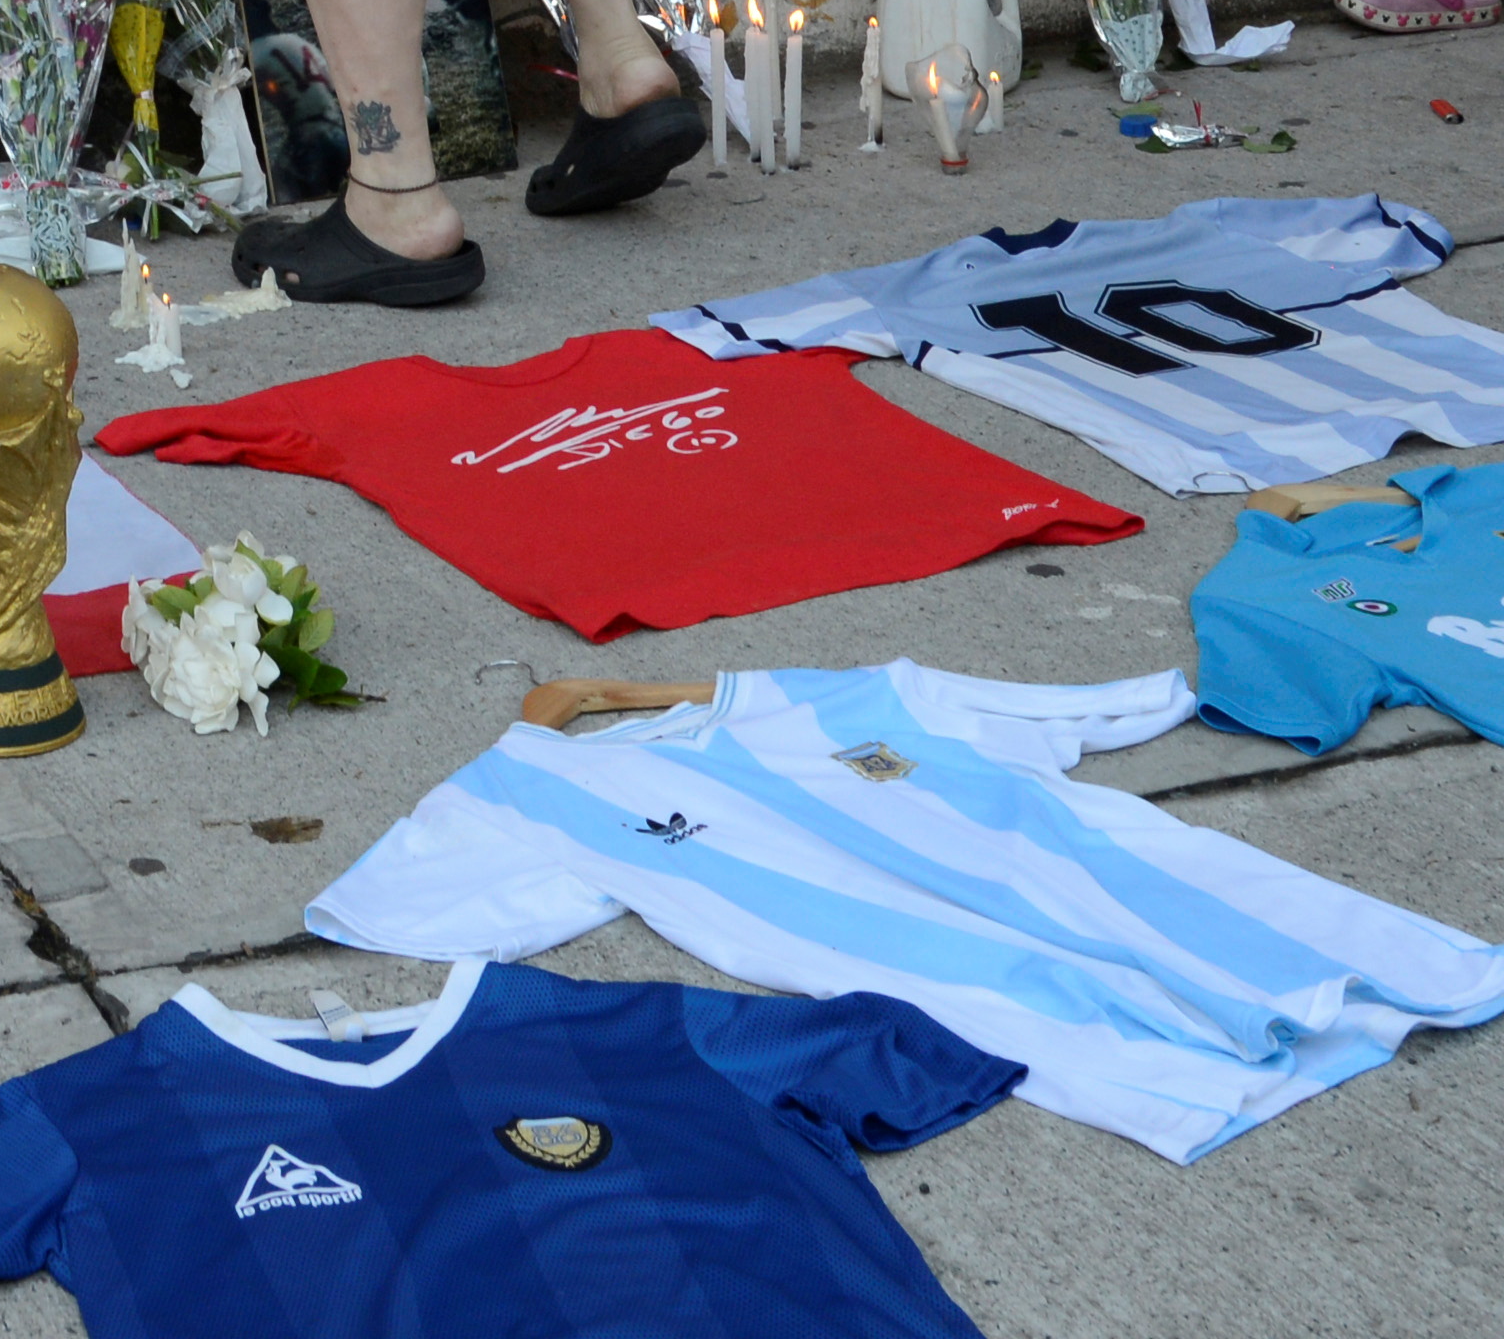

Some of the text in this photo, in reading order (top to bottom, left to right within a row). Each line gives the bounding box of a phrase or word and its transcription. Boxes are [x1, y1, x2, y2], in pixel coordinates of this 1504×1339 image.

[967, 279, 1323, 378] 10
[236, 1203, 256, 1219] le
[258, 1194, 296, 1212] coq
